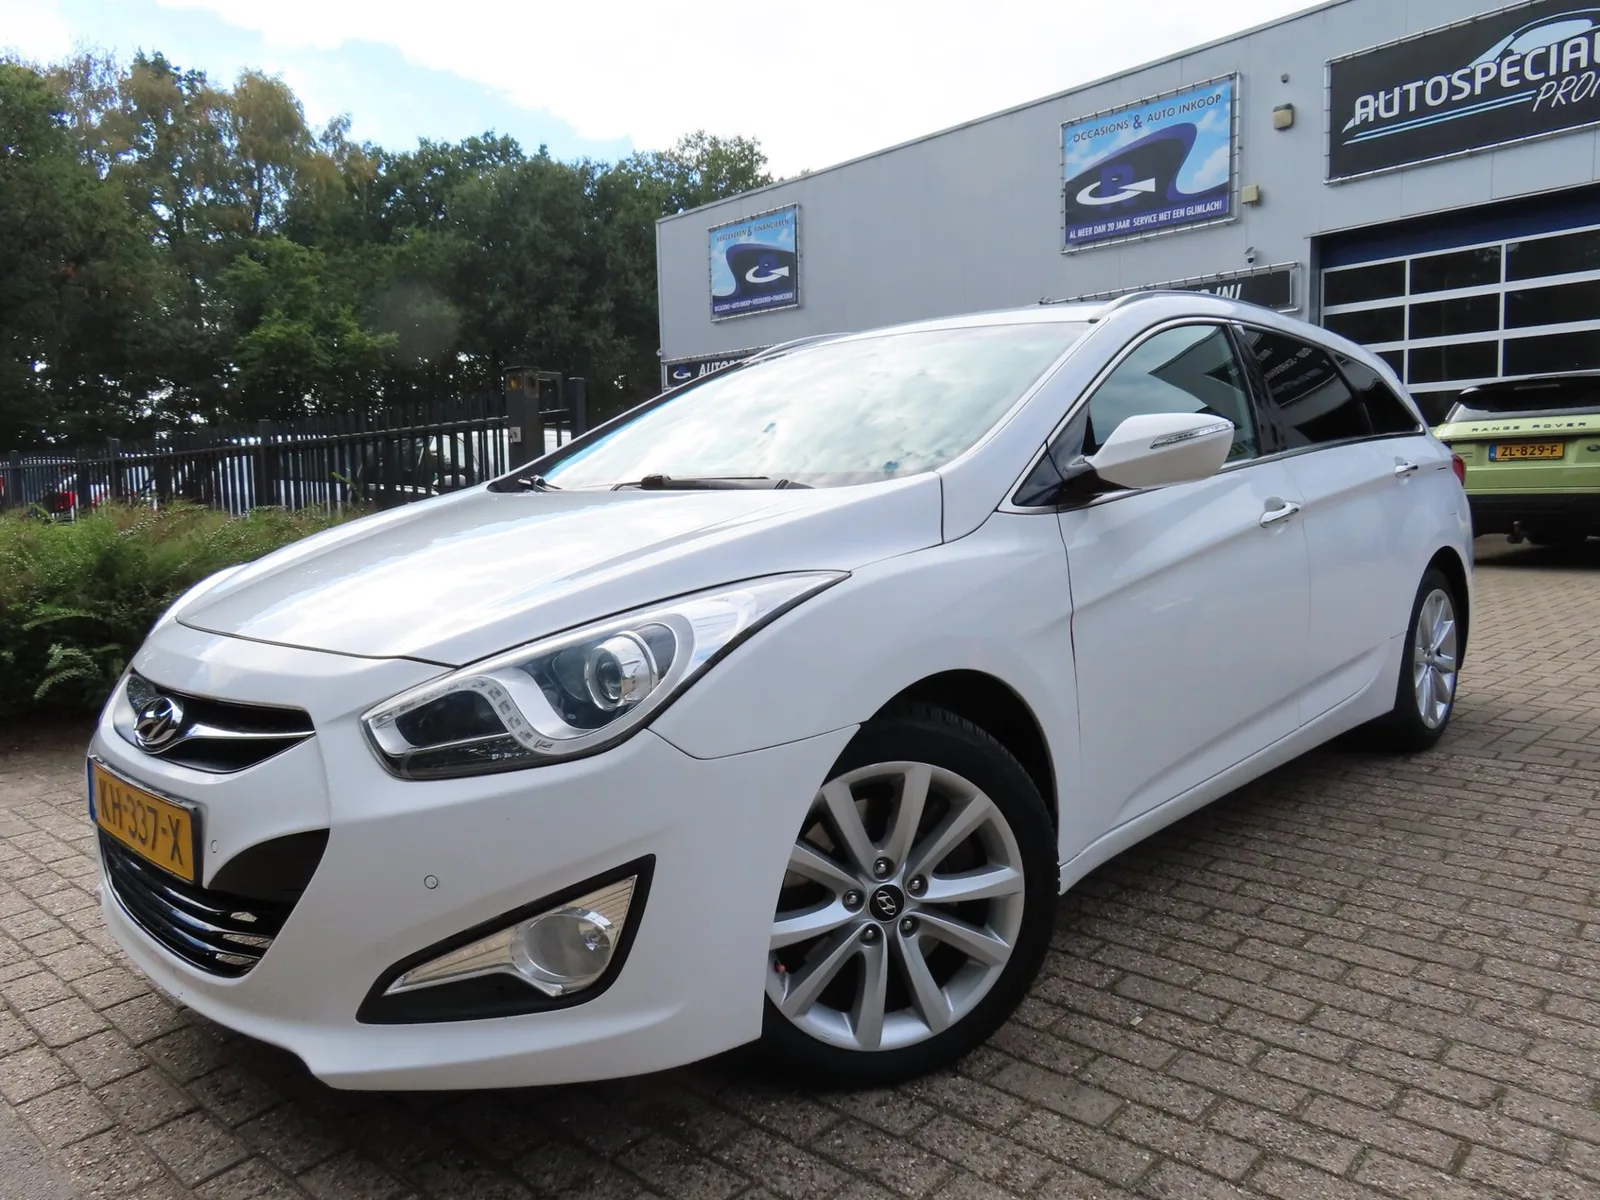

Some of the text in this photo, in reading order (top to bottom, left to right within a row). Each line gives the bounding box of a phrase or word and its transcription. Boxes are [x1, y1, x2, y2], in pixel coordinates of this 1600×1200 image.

[1073, 93, 1222, 143] OCCASIONS & AUTO INKOOP
[1069, 200, 1222, 240] AL MEER DAN 20 JAAR SERVICE MET EEN GLIMLACH!
[1500, 444, 1559, 457] ZL-829-F
[98, 776, 186, 868] KH-337-X
